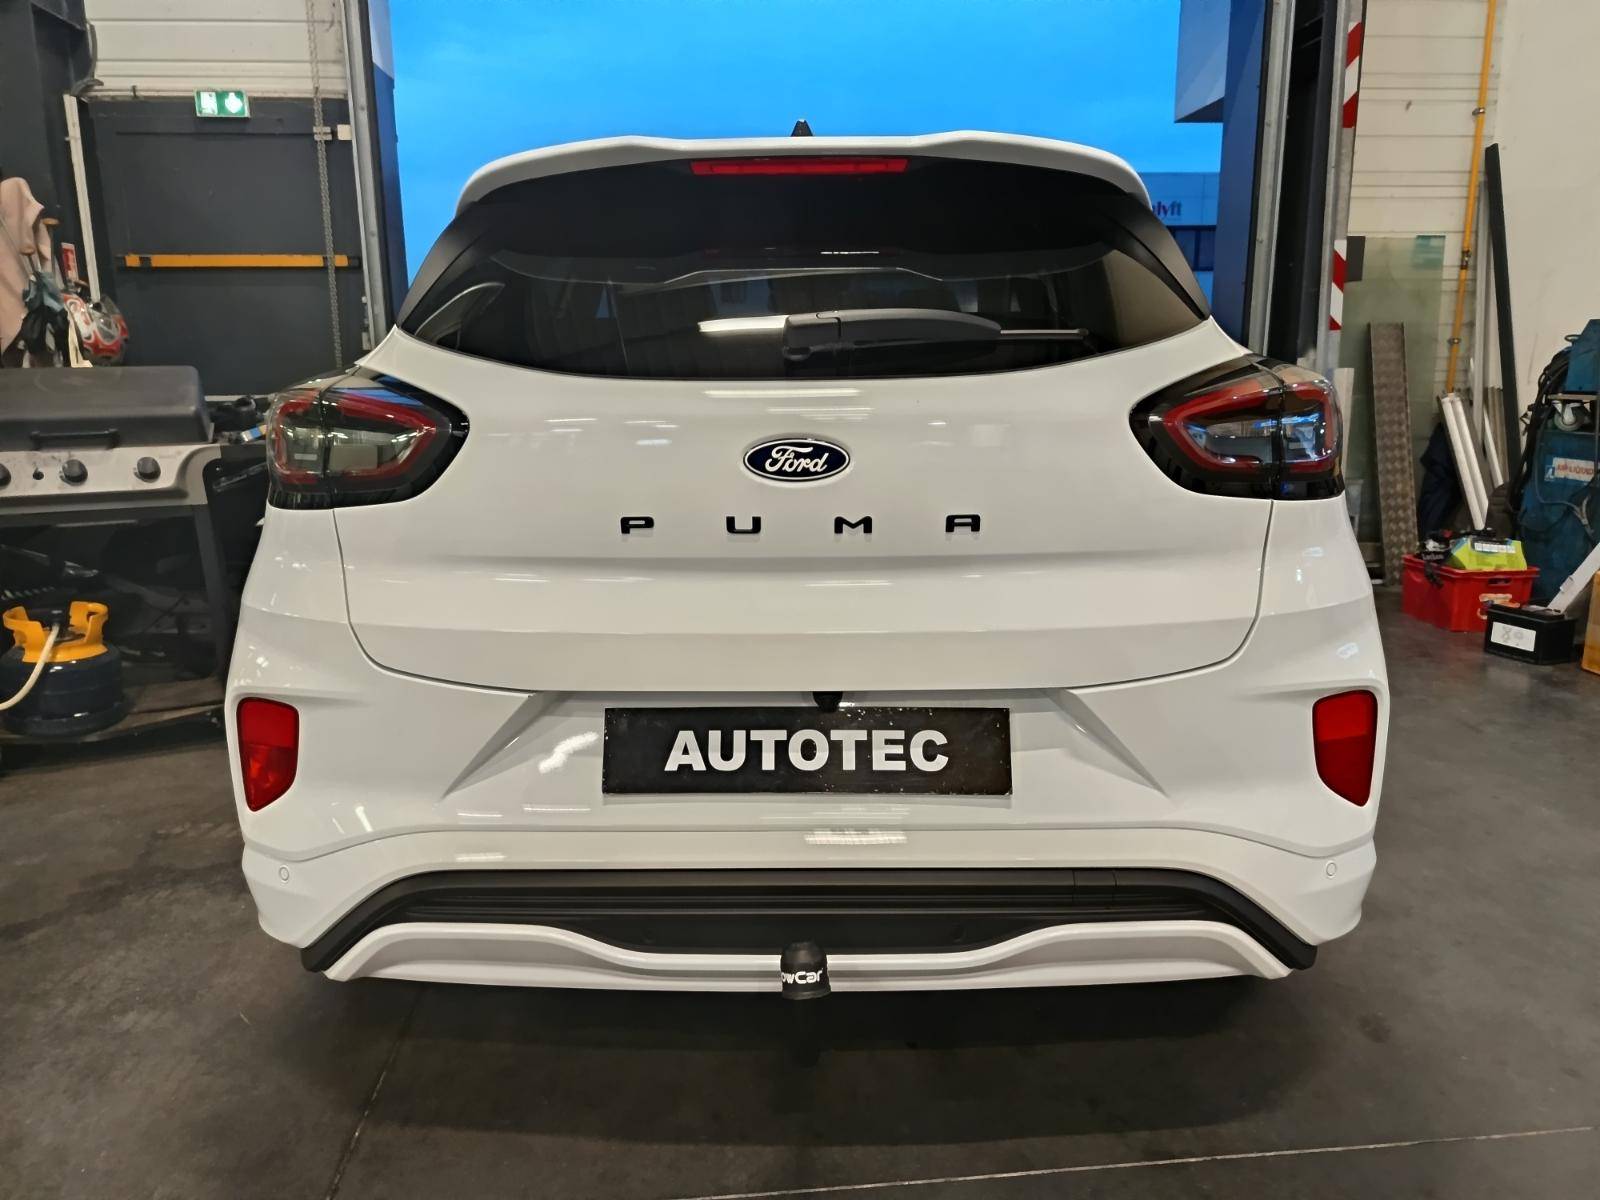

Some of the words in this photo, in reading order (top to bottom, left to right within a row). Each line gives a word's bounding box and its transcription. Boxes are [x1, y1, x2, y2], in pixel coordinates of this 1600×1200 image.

[765, 445, 829, 473] Ford
[620, 514, 981, 534] PUMA
[664, 729, 949, 772] AUTOTEC
